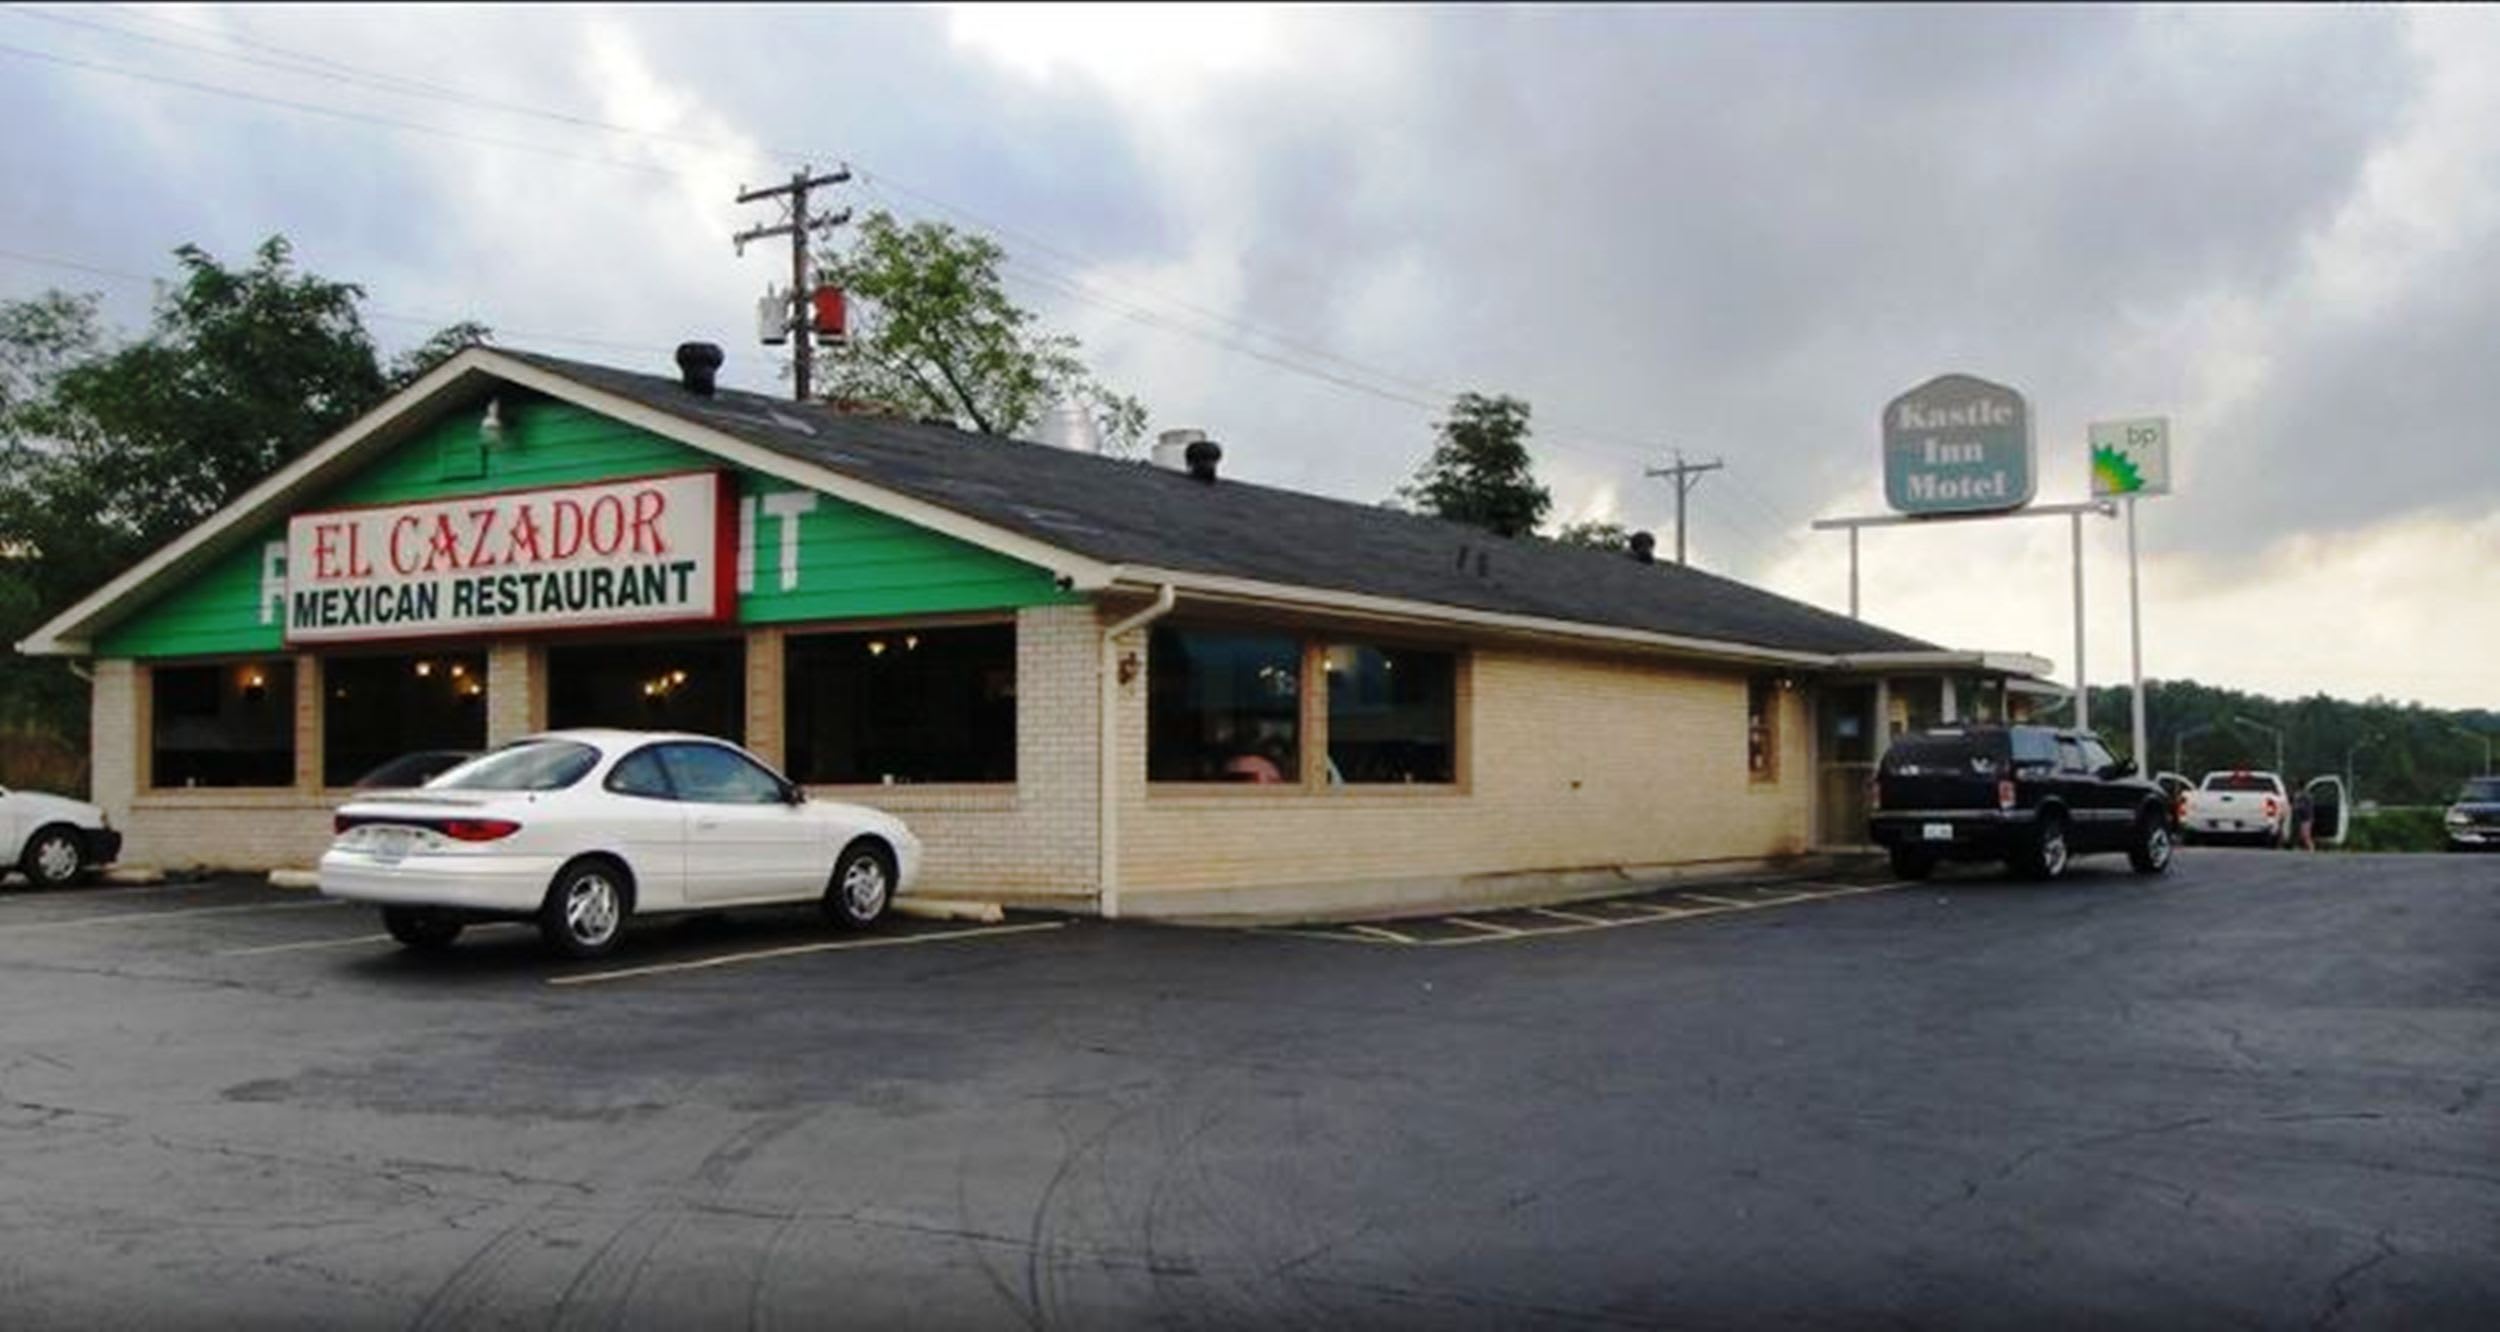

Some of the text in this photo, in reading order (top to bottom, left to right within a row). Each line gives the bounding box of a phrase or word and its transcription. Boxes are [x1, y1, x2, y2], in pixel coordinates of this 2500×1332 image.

[1902, 401, 2012, 428] Kastle
[2127, 427, 2159, 447] bp
[1924, 439, 1983, 464] Inn
[1908, 470, 2006, 500] Motel
[313, 489, 666, 579] EL CAZADOR
[293, 561, 695, 628] MEXICAN RESTAURANT
